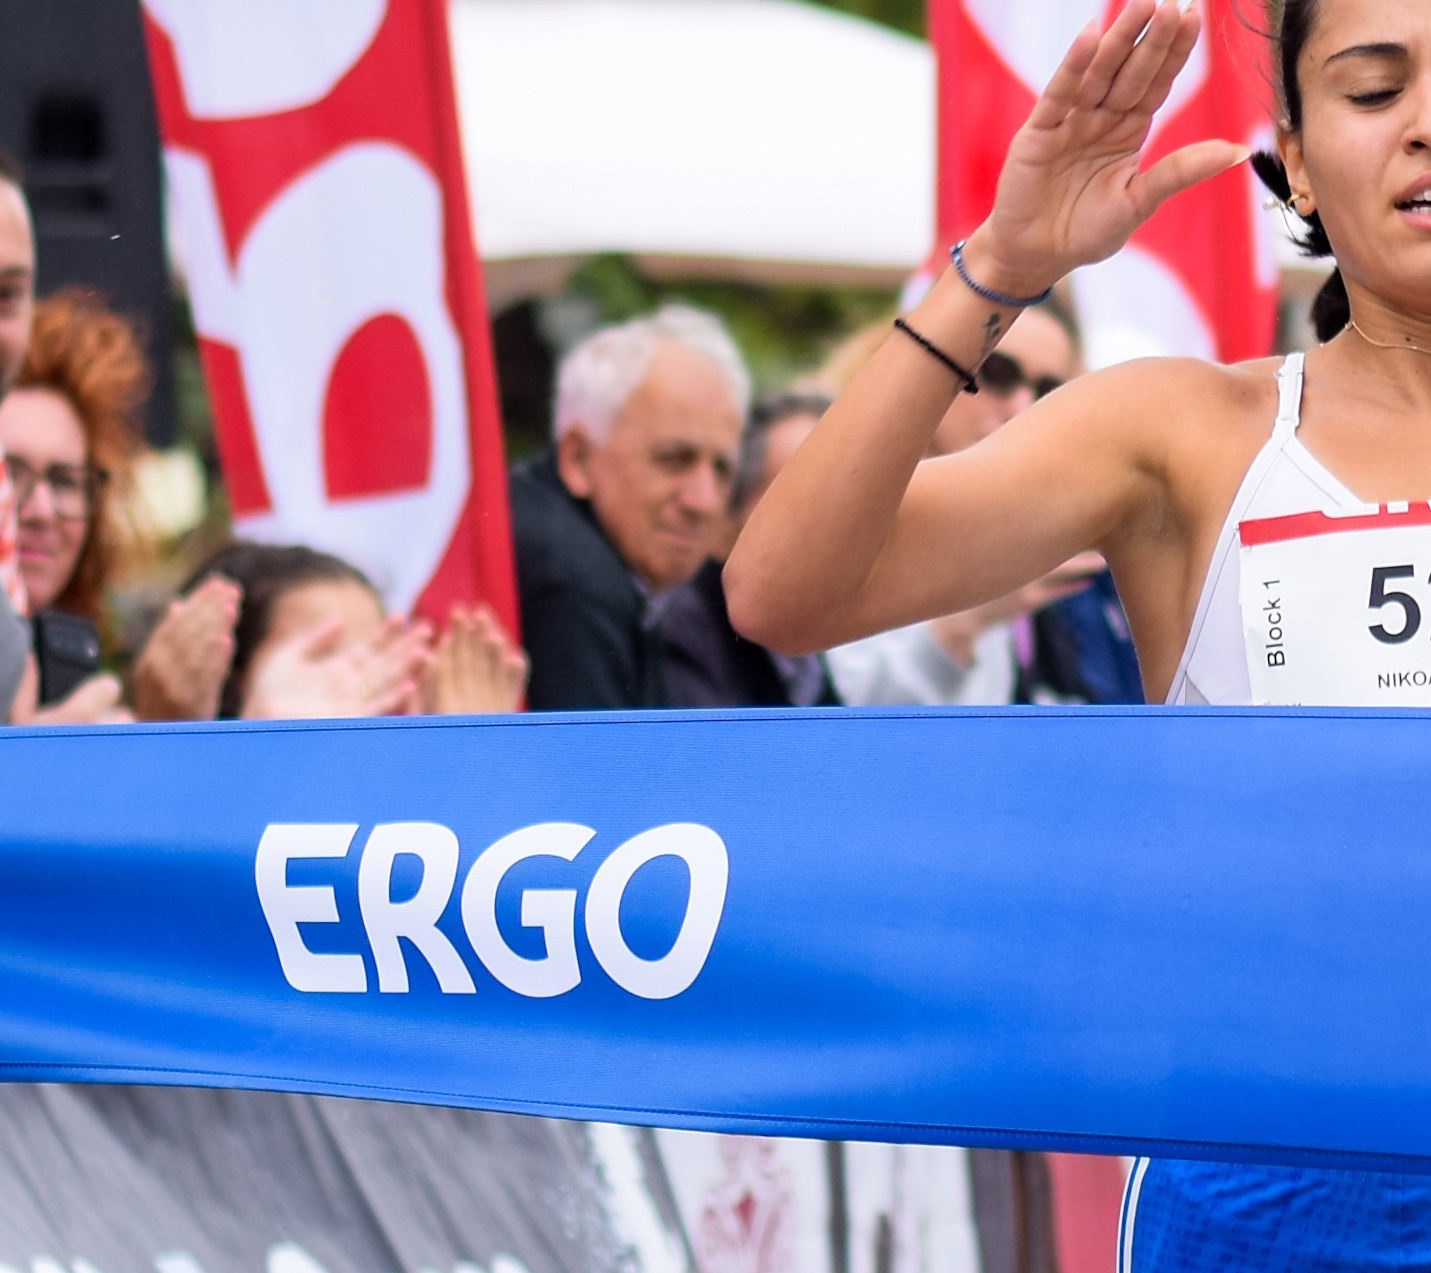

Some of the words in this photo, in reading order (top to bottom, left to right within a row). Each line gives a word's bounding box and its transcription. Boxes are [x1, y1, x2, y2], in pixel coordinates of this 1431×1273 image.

[1263, 578, 1280, 589] 1
[1262, 596, 1286, 668] Block
[255, 822, 729, 1000] ERGO
